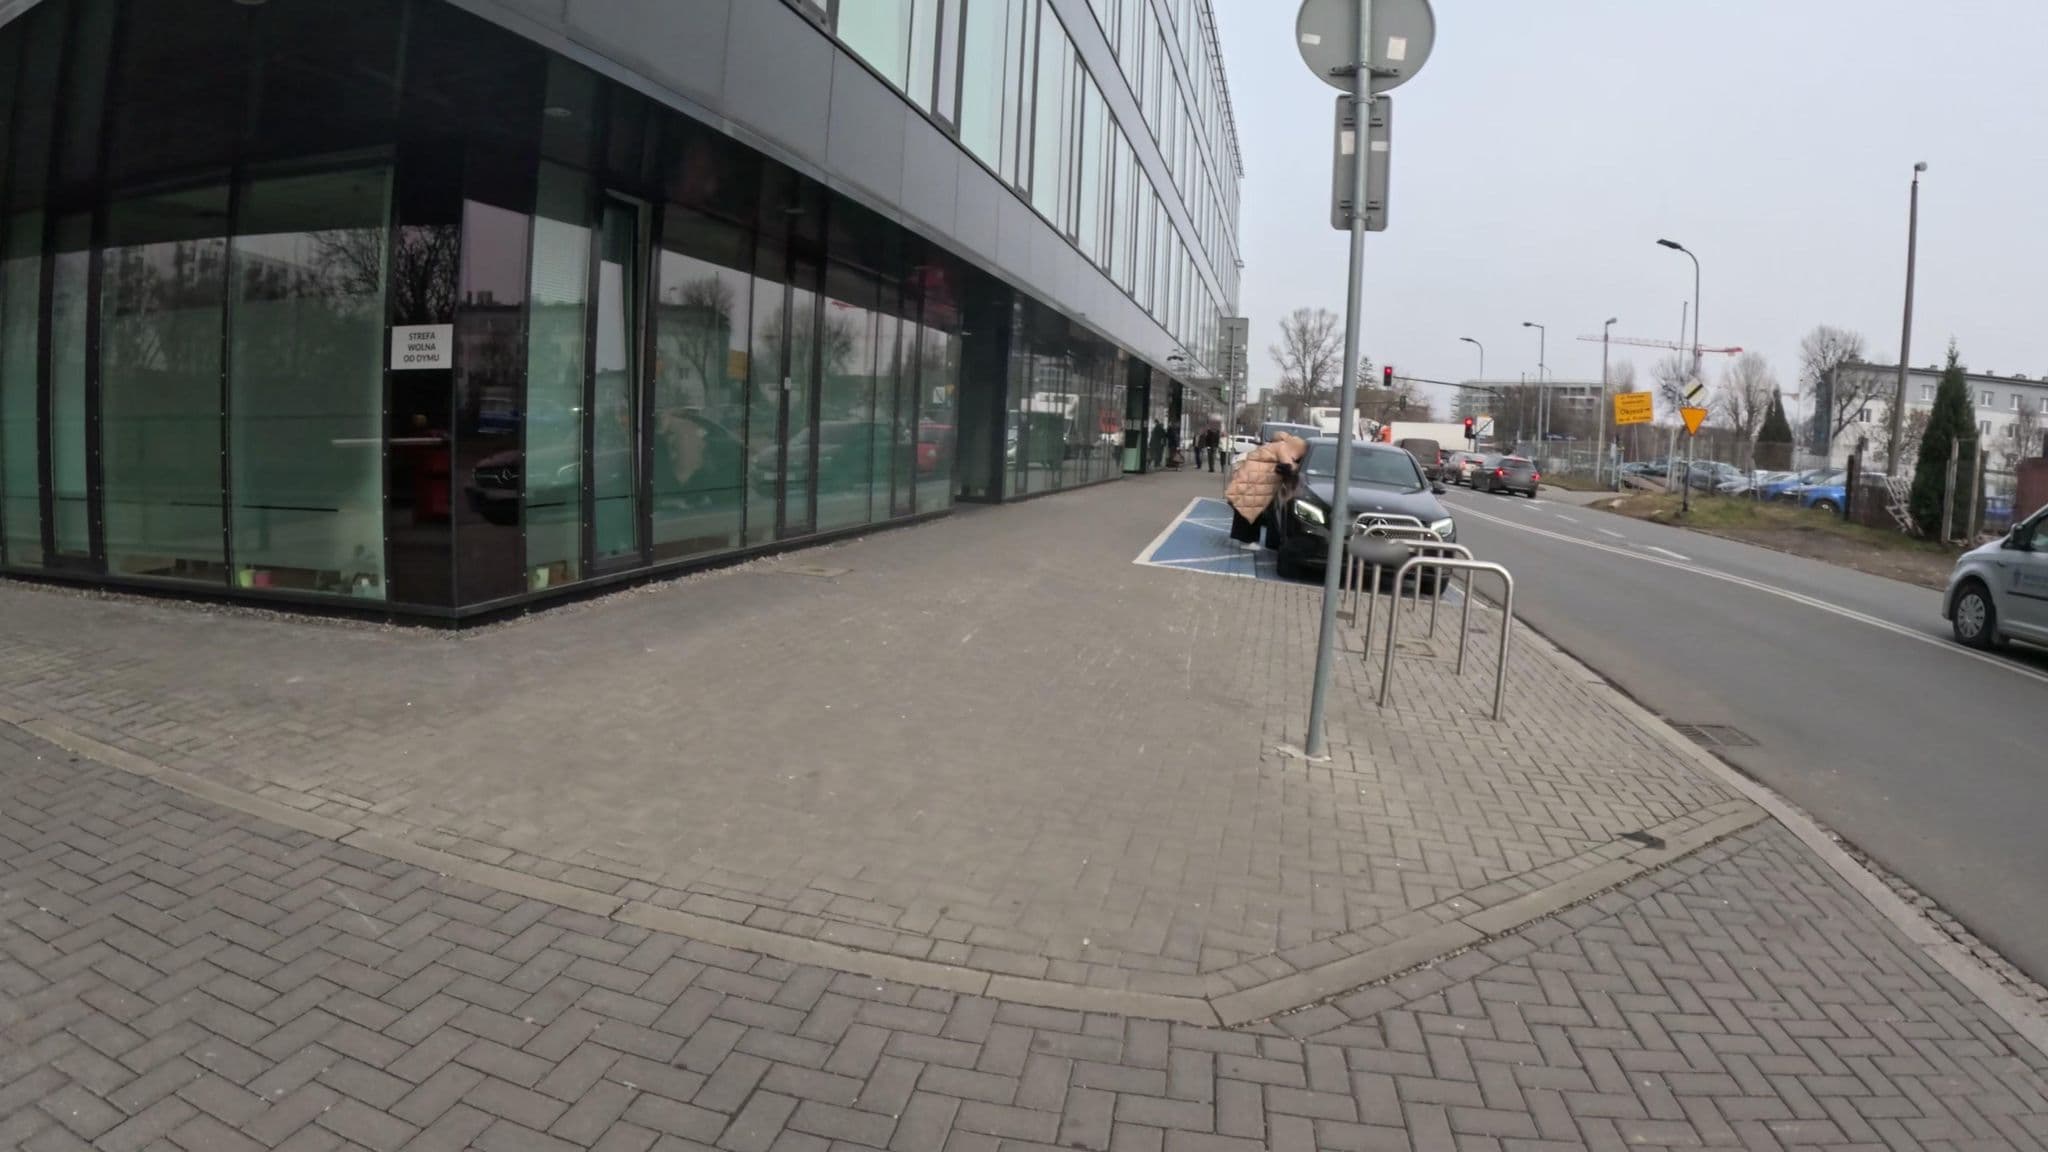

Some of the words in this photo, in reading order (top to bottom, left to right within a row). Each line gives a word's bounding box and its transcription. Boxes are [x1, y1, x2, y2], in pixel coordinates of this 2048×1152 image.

[409, 332, 435, 340] STREFA
[408, 343, 436, 351] WOLNA
[403, 354, 415, 362] OD
[416, 354, 440, 362] DYMU
